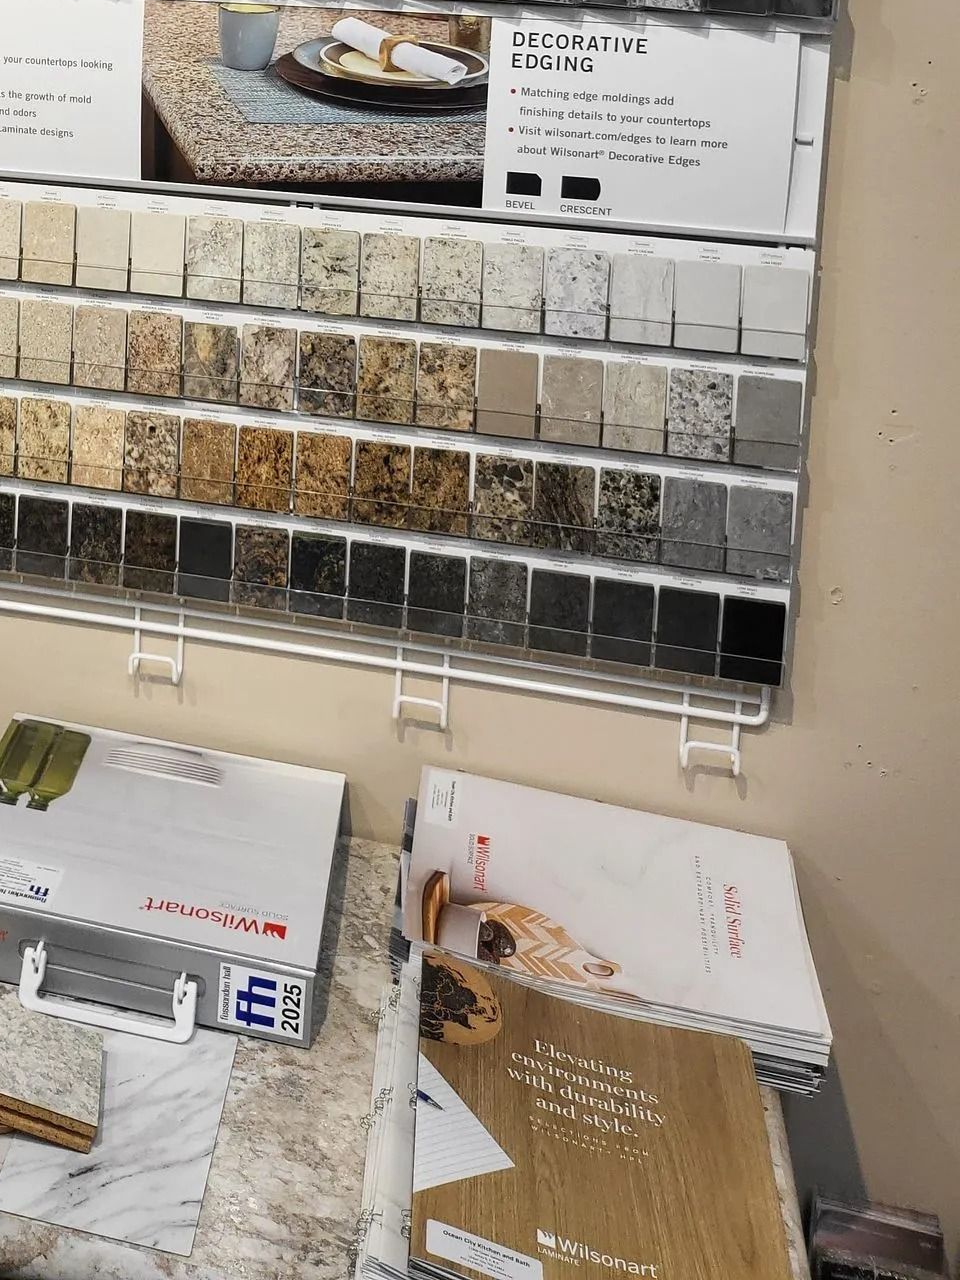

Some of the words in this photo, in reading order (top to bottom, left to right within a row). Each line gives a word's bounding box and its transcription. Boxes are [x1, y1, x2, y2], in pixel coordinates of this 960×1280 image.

[512, 31, 648, 54] DECORATIVE
[3, 56, 22, 66] your
[25, 55, 78, 68] countertops
[80, 58, 113, 71] looking
[511, 53, 594, 73] EDGING
[8, 88, 23, 99] the
[25, 90, 55, 103] growth
[57, 91, 67, 102] of
[69, 93, 92, 104] mold
[520, 87, 570, 101] Matching
[572, 90, 598, 102] edge
[601, 92, 651, 106] moldings
[653, 95, 675, 106] add
[13, 107, 37, 118] odors
[519, 106, 565, 120] finishing
[567, 109, 603, 121] details
[606, 112, 617, 122] to
[620, 114, 644, 125] your
[646, 114, 711, 129] countertops
[40, 126, 74, 138] designs
[518, 126, 542, 137] Visit
[544, 127, 652, 145] wilsonart.com/edges
[655, 135, 666, 145] to
[669, 136, 697, 147] learn
[700, 140, 728, 150] more
[517, 145, 547, 156] about
[608, 151, 664, 165] Decorative
[668, 155, 701, 167] Edges
[505, 200, 536, 211] BEVEL
[560, 204, 612, 216] CRESCENT
[723, 884, 742, 916] Solid
[726, 916, 745, 959] Surface
[281, 983, 302, 1034] 2025
[534, 1039, 633, 1084] Elevating
[511, 1052, 659, 1104] environments
[507, 1067, 553, 1093] with
[560, 1085, 665, 1127] durability
[536, 1097, 576, 1120] and
[582, 1113, 639, 1138] style.
[616, 1144, 649, 1157] FROM
[442, 1229, 463, 1241] Ocean
[464, 1235, 476, 1247] City
[477, 1241, 501, 1256] Kitchen
[502, 1252, 514, 1261] and
[515, 1256, 530, 1268] Bath
[537, 1246, 581, 1266] LAMINATE
[557, 1236, 658, 1278] Wilsonart
